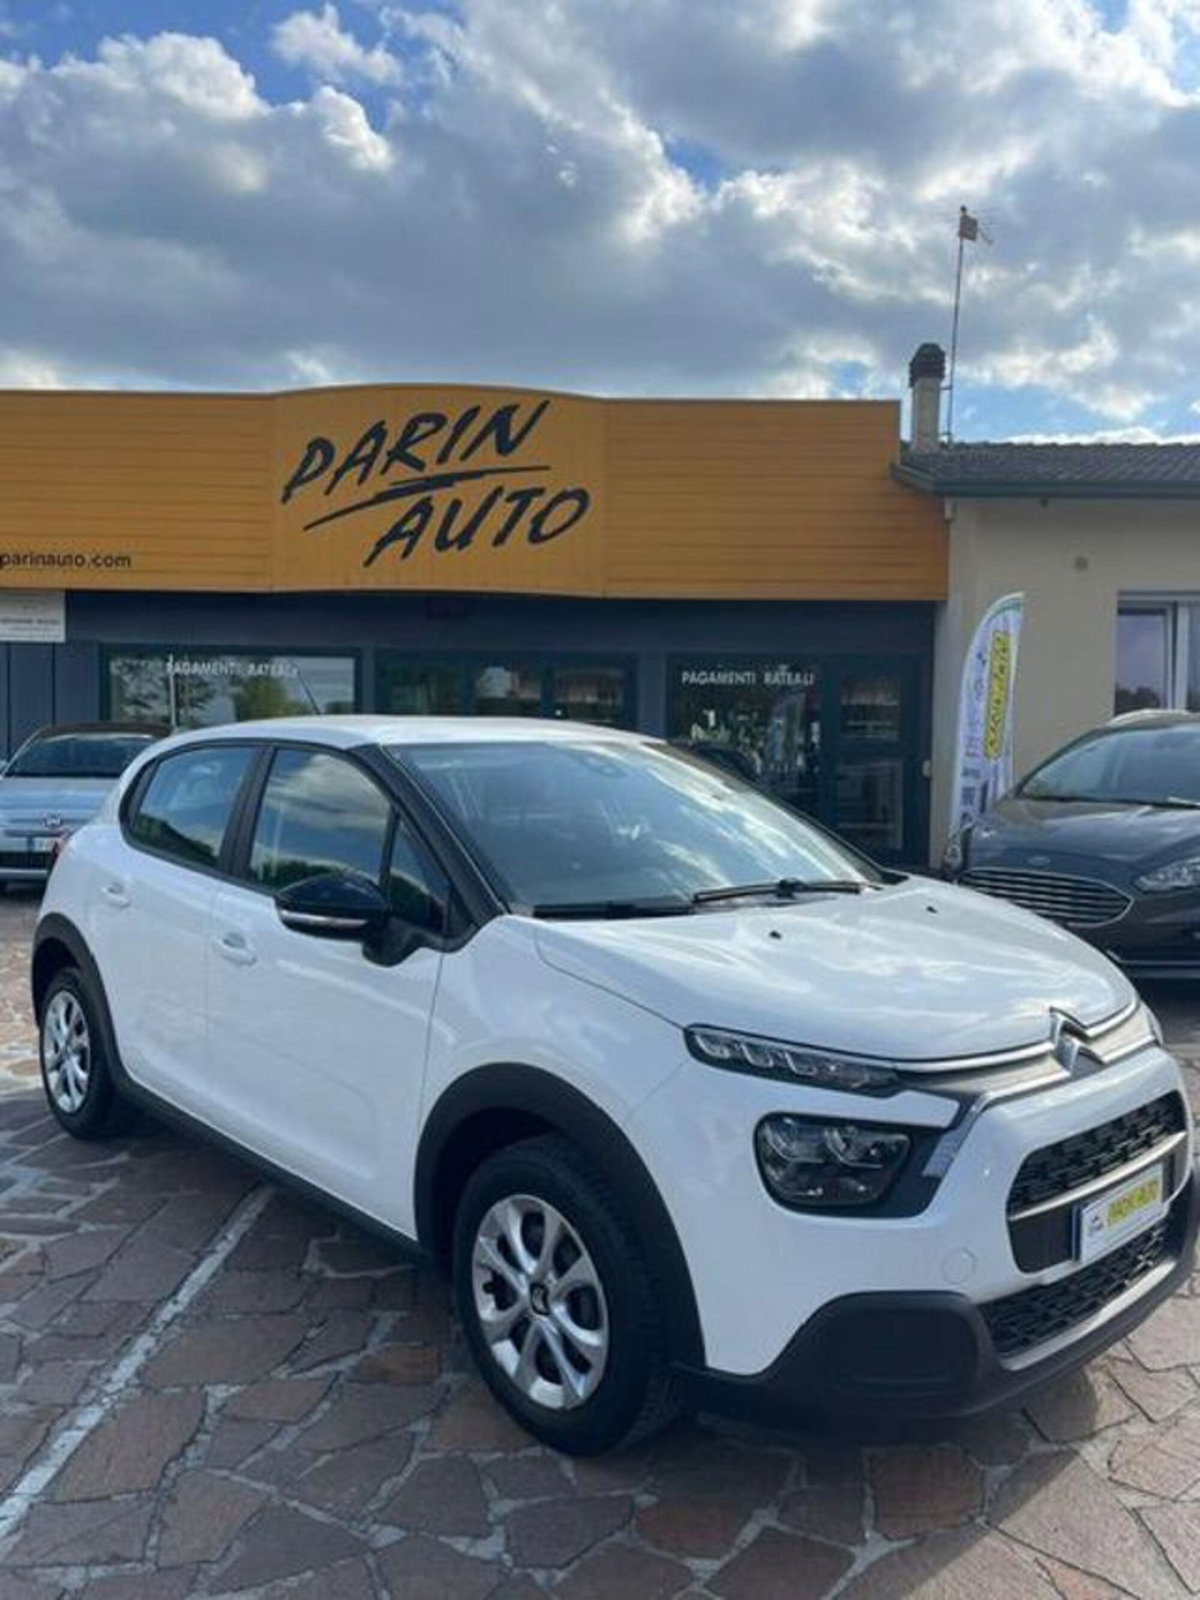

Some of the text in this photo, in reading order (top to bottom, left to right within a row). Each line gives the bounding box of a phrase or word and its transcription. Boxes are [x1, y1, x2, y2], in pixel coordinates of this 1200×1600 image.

[281, 399, 550, 504] PARIN
[362, 486, 591, 568] AUTO
[681, 670, 757, 686] PAGAMENTI
